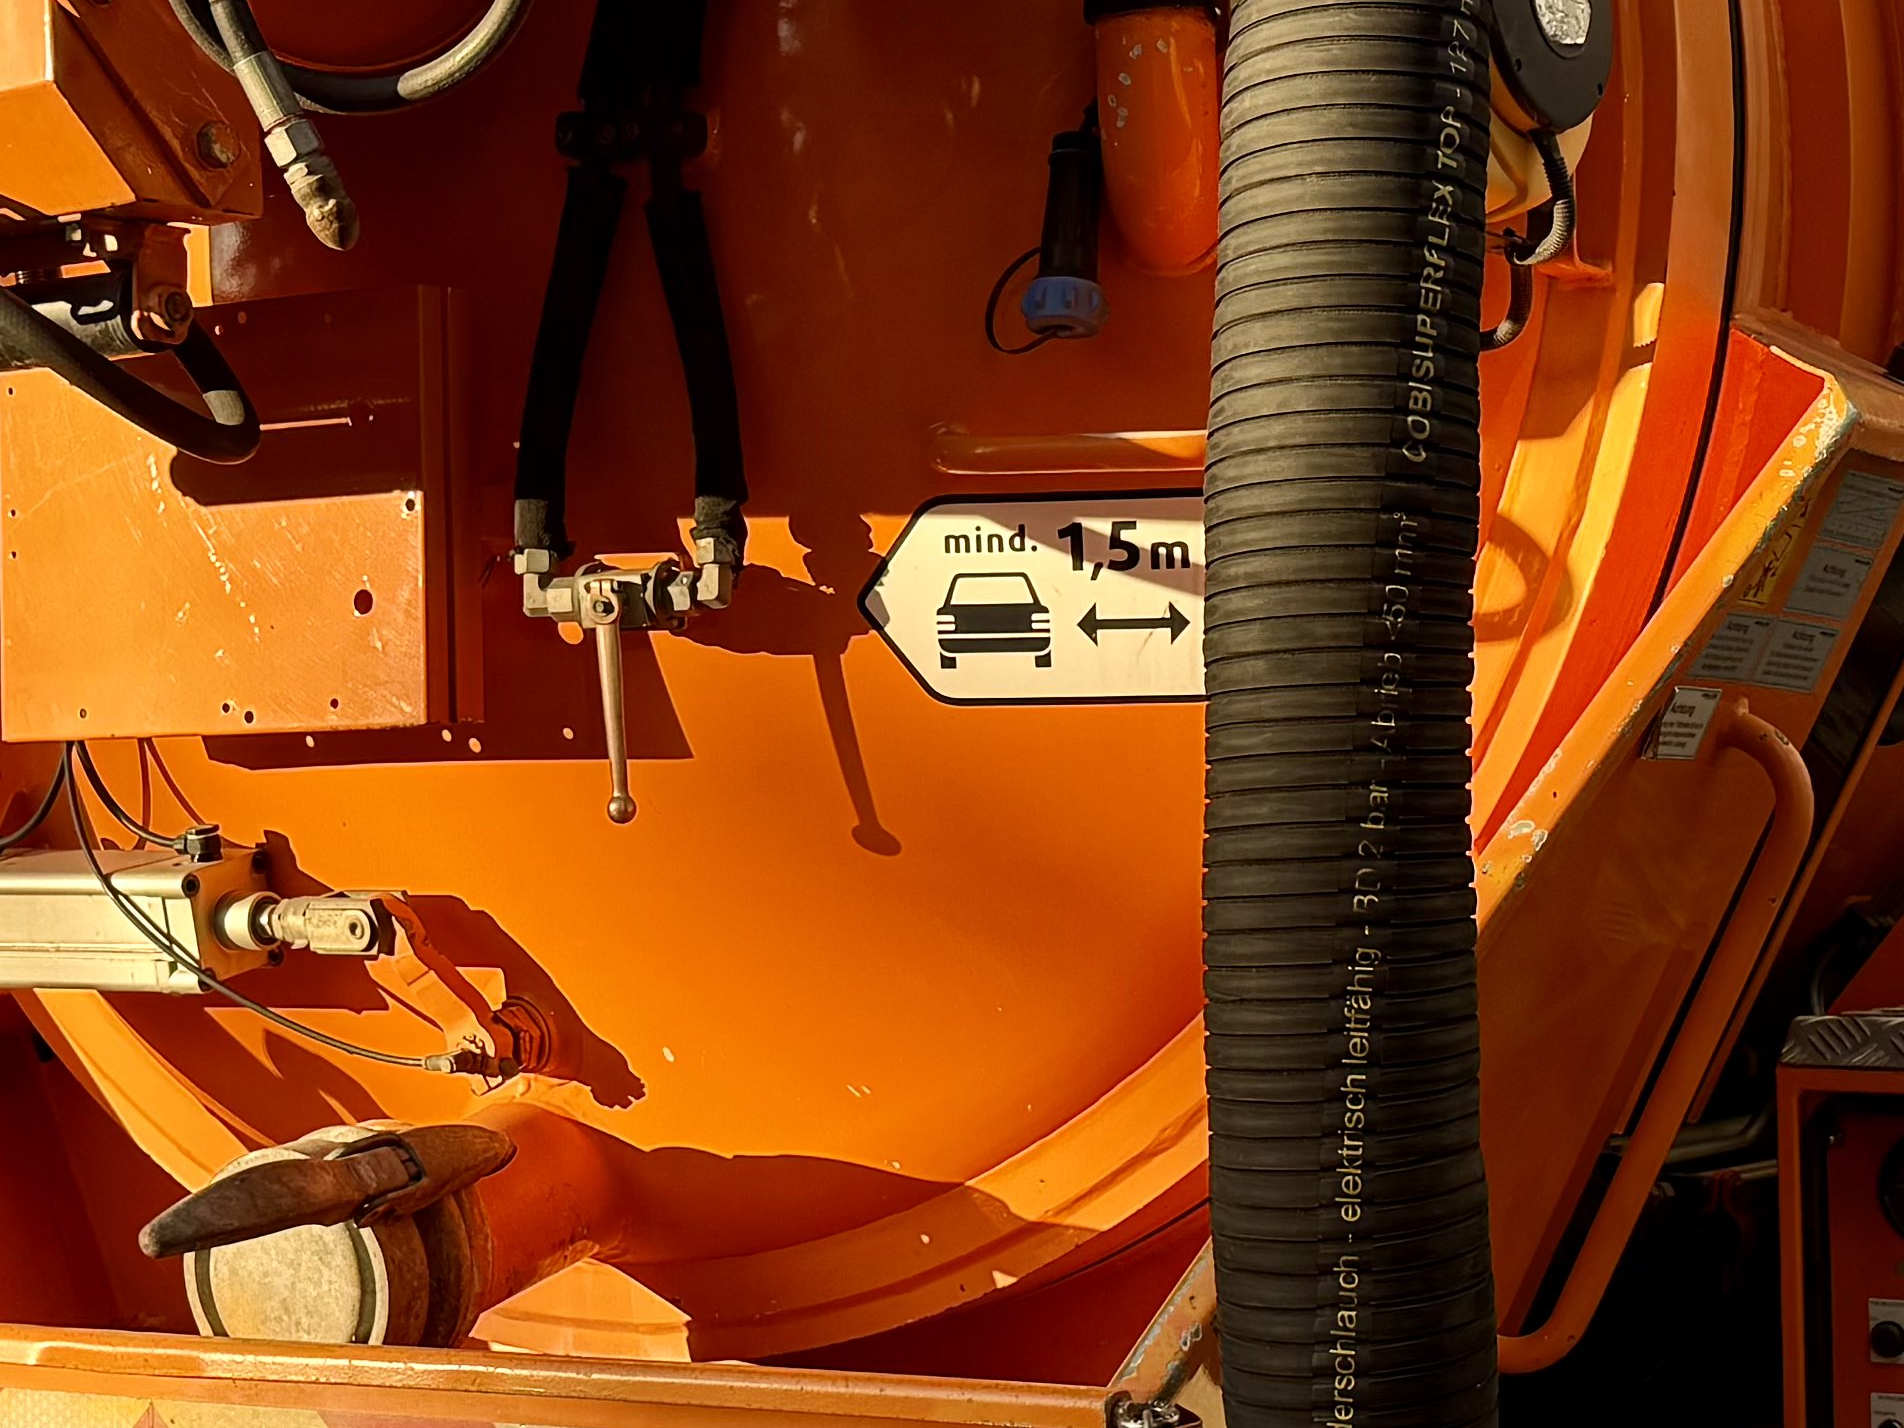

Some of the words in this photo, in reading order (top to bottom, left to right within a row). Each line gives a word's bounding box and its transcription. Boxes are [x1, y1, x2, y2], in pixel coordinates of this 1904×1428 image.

[1402, 181, 1458, 462] COBISUPERFLEX
[1437, 106, 1464, 169] TOP
[944, 523, 1039, 555] mind.
[1370, 652, 1403, 755] Abrieb
[1360, 782, 1389, 829] bar
[1342, 946, 1381, 1064] leitfähig
[1335, 1074, 1366, 1221] elektrisch
